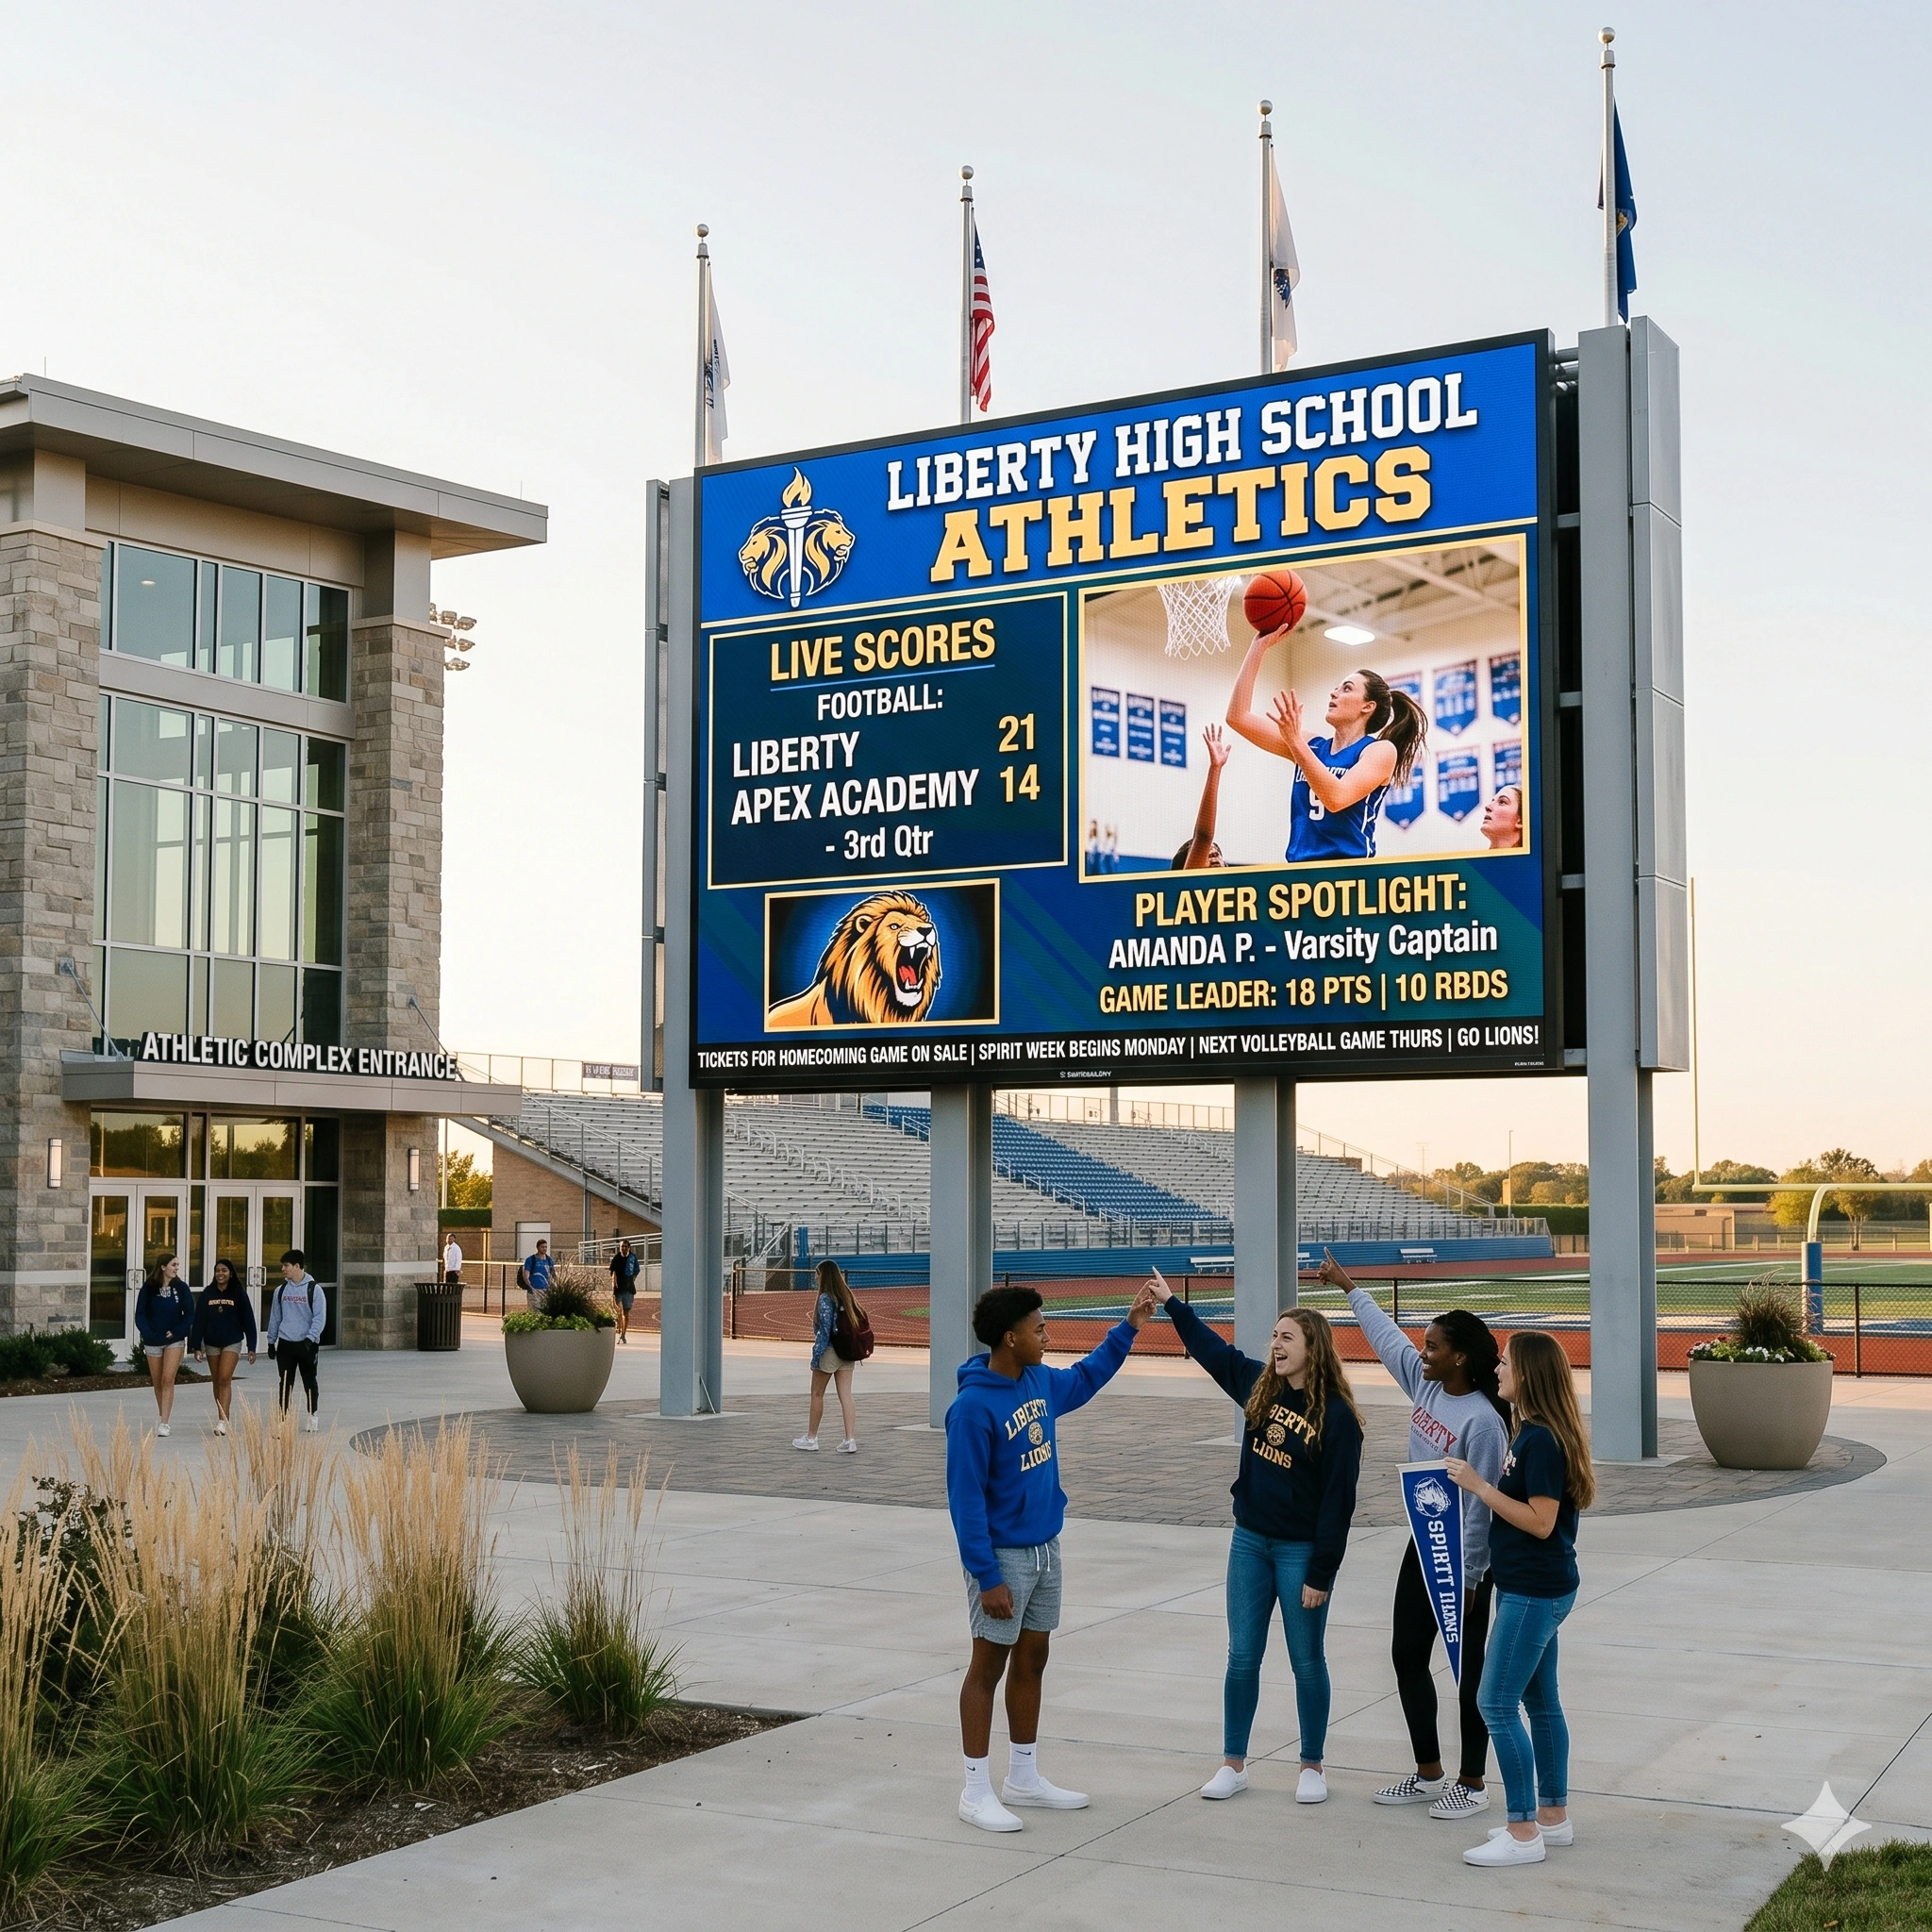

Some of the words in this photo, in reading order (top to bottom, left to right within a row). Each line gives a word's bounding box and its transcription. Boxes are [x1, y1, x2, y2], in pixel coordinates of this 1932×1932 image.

[887, 430, 1097, 510] LIBERTY
[1115, 407, 1242, 477] HIGH
[1260, 372, 1477, 454] SCHOOL
[929, 445, 1431, 582] ATHLETICS
[772, 636, 842, 680] LIVE
[854, 618, 994, 672] SCORES
[818, 684, 942, 720] FOOTBALL:
[734, 731, 859, 777] LIBERTY
[999, 714, 1033, 752] 21
[731, 784, 811, 824] APEX
[820, 769, 979, 818] ACADEMY
[1001, 764, 1040, 802] 14
[844, 827, 885, 859] 3rd
[895, 825, 933, 857] Qtr
[1137, 887, 1257, 926] PLAYER
[1269, 874, 1466, 919] SPOTLIGHT:
[1109, 935, 1226, 968] AMANDA
[1236, 933, 1255, 962] P.
[1285, 927, 1379, 963] Varsity
[1390, 921, 1496, 960] Captain
[1100, 985, 1167, 1012] GAME
[1176, 980, 1275, 1009] LEADER:
[1287, 978, 1315, 1005] 18
[1324, 975, 1371, 1004] PTS
[1396, 974, 1426, 1001] 10
[1436, 970, 1507, 999] RBDS
[142, 1032, 248, 1067] ATHLETIC
[255, 1040, 353, 1073] COMPLEX
[358, 1048, 457, 1079] ENTRANCE
[698, 1051, 748, 1068] TICKETS
[752, 1050, 775, 1066] FOR
[780, 1047, 866, 1065] HOMECOMING
[871, 1046, 908, 1063] GAME
[912, 1045, 929, 1061] ON
[934, 1044, 967, 1061] SALE
[979, 1042, 1023, 1059] SPIRIT
[1026, 1041, 1065, 1058] WEEK
[1070, 1040, 1120, 1057] BEGINS
[1125, 1038, 1186, 1056] MONDAY
[1200, 1036, 1237, 1053] NEXT
[1241, 1033, 1336, 1052] VOLLEYBALL
[1341, 1031, 1385, 1049] GAME
[1390, 1029, 1442, 1048] THURS
[1457, 1027, 1479, 1046] GO
[1486, 1025, 1538, 1045] LIONS!
[1269, 1404, 1316, 1445] BERTY
[1252, 1437, 1292, 1469] LIONS
